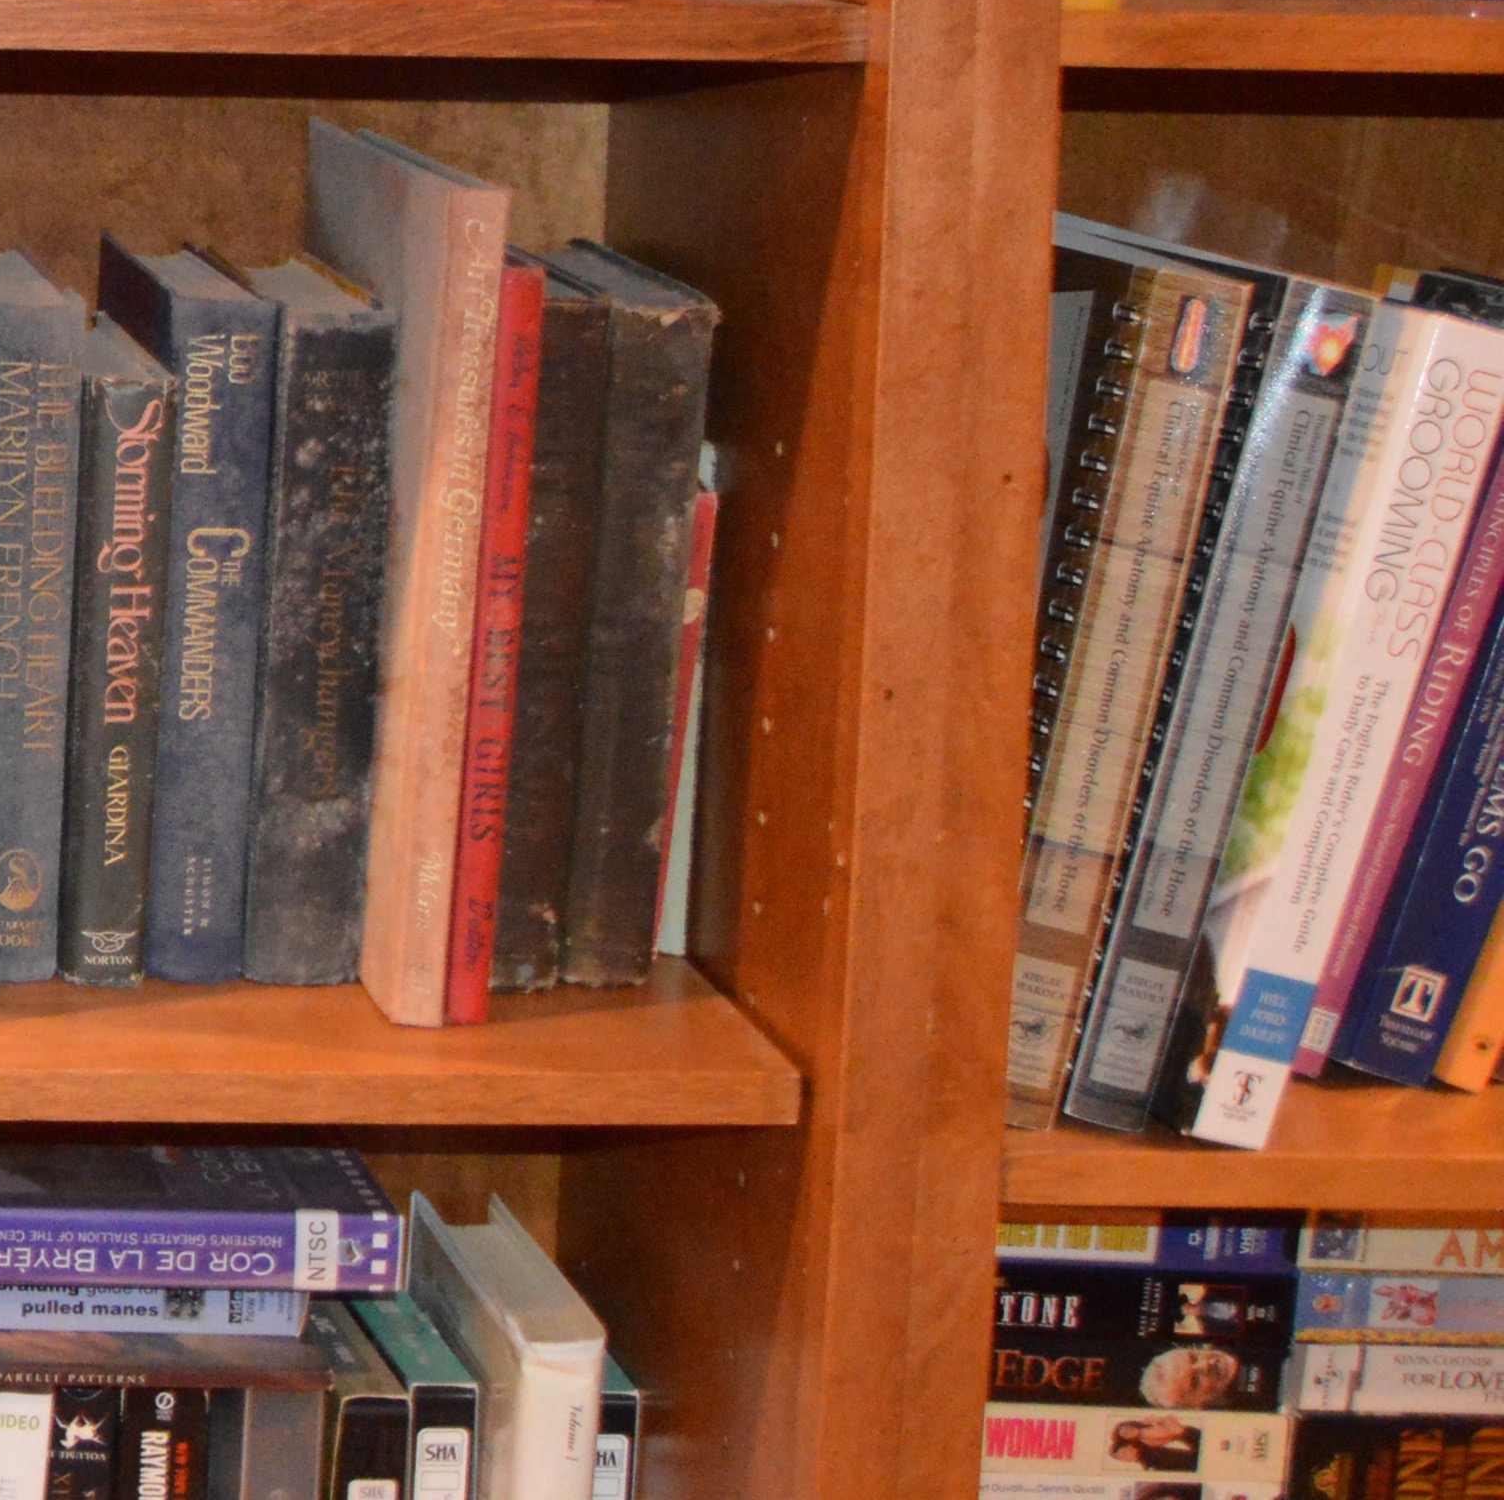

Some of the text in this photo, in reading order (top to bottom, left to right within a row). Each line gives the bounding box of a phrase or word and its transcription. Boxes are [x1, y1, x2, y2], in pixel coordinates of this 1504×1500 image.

[179, 332, 226, 475] Woodward
[1364, 357, 1462, 603] GROOMING
[1387, 369, 1503, 661] WORLD-CLASS
[96, 394, 166, 725] Storming Heaven
[175, 524, 252, 724] COMMANDERS
[1158, 408, 1314, 918] Clinical Equine Anatomy and Common Disorders of the Horse
[1370, 680, 1390, 710] The
[1402, 642, 1470, 767] RIDING
[1349, 712, 1380, 770] English
[103, 744, 132, 866] GIARDINA
[1307, 831, 1342, 905] Complete
[1454, 846, 1490, 902] GO
[82, 954, 135, 965] NORTON
[1291, 908, 1317, 954] Guide
[306, 1220, 328, 1281] NTSC
[20, 1298, 159, 1318] pulled manes
[67, 1372, 146, 1385] PATTERNS
[984, 1416, 1077, 1461] WOMAN
